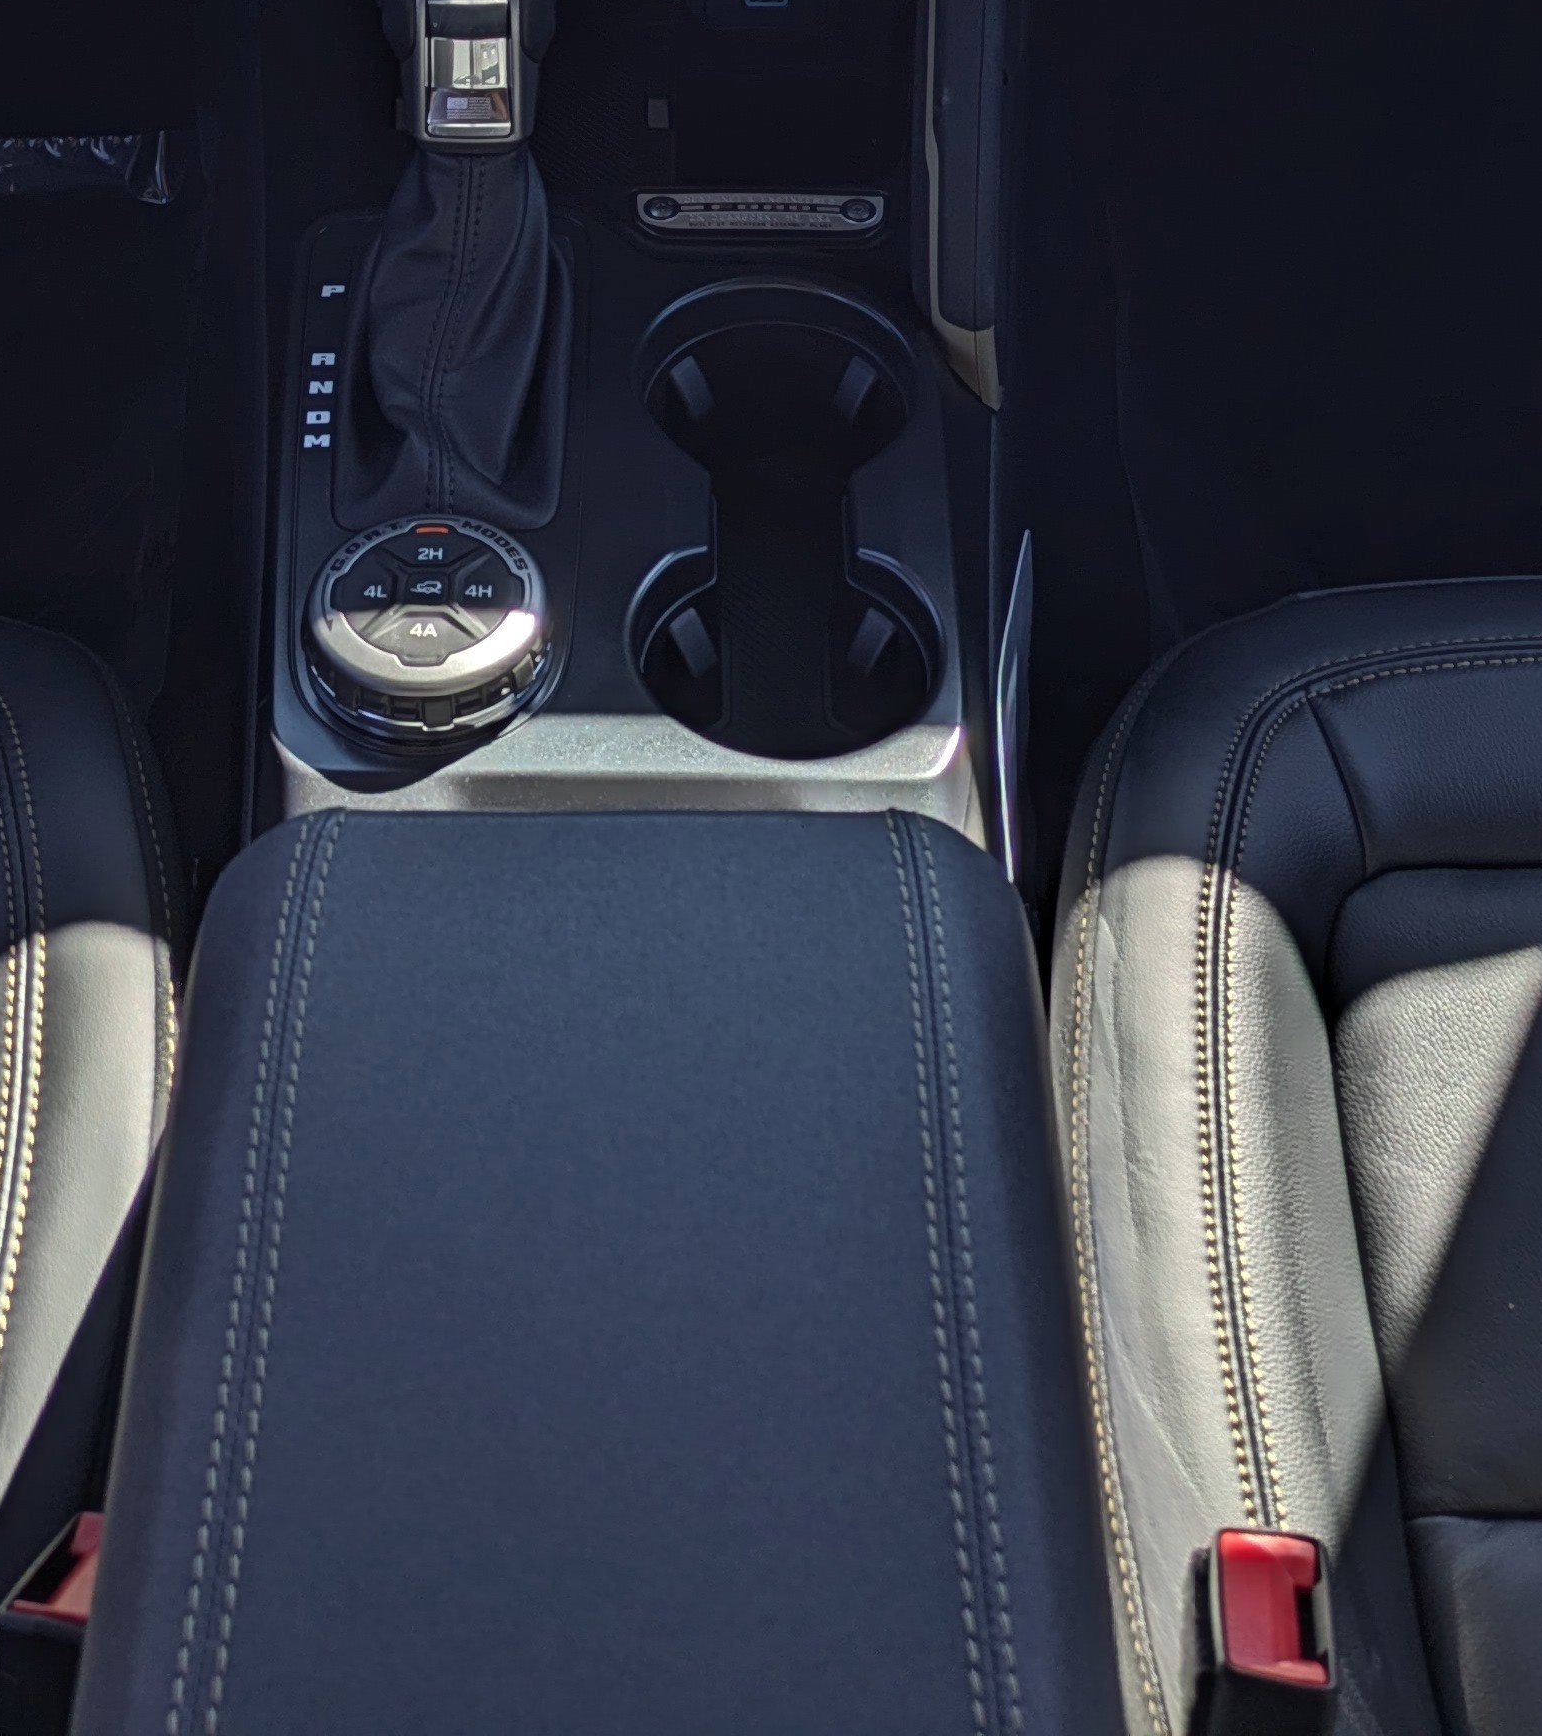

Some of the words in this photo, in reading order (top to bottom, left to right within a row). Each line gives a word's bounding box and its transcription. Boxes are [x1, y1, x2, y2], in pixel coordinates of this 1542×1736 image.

[321, 285, 346, 298] P
[309, 380, 334, 394] N
[306, 410, 331, 424] D
[303, 433, 331, 448] M
[461, 519, 529, 572] MODES
[417, 547, 443, 561] 2H
[363, 585, 388, 598] 4L
[464, 585, 492, 598] 4H
[409, 623, 438, 638] 4A
